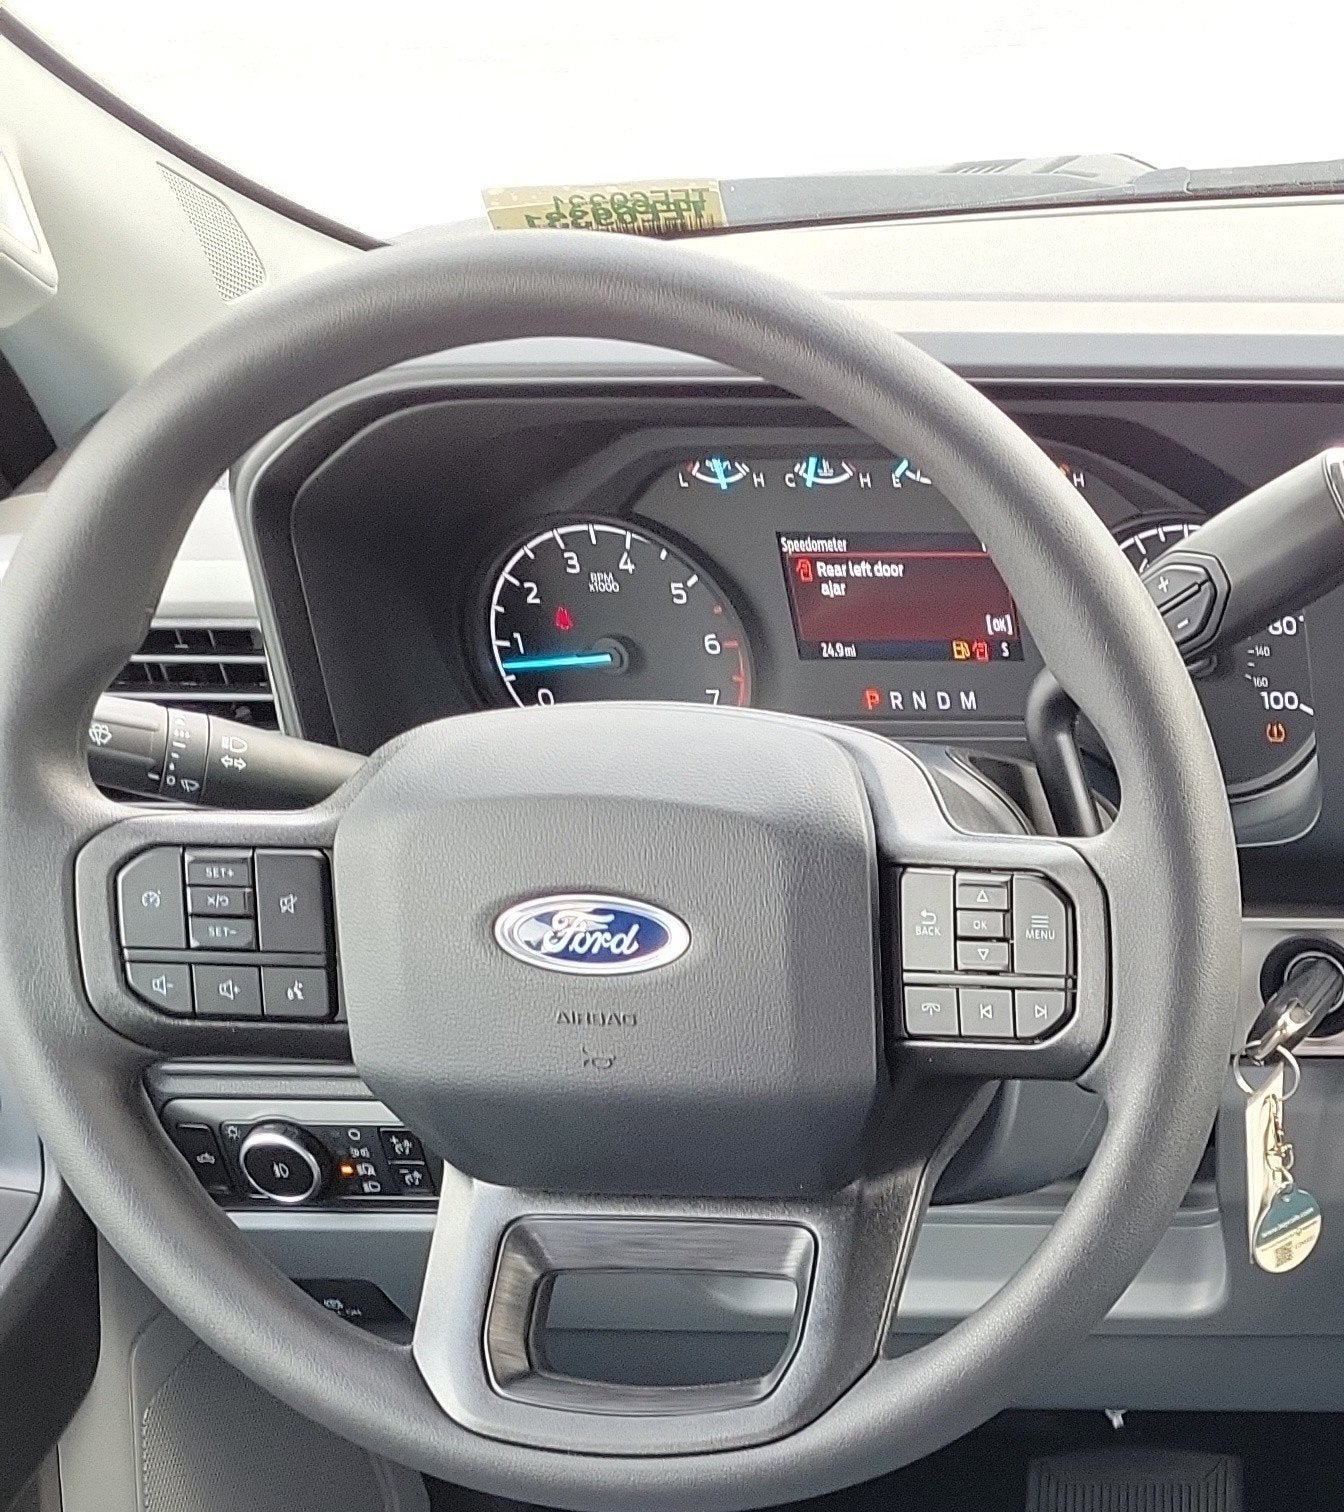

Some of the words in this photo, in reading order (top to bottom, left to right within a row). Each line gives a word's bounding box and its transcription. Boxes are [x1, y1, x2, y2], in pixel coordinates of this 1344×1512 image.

[678, 473, 689, 488] L
[753, 472, 765, 488] H
[785, 473, 796, 488] C
[859, 472, 872, 488] H
[1073, 473, 1085, 488] H
[780, 536, 847, 554] Speedometer
[564, 552, 581, 574] 3
[618, 552, 635, 574] 4
[816, 561, 847, 577] Rear
[849, 560, 873, 578] left
[874, 560, 904, 577] door
[590, 571, 615, 583] RPM
[524, 582, 541, 604] 2
[671, 582, 688, 605] 5
[821, 581, 846, 598] ajar
[512, 633, 525, 655] 1
[704, 633, 721, 655] 6
[1001, 641, 1010, 657] S
[1255, 645, 1270, 656] 140
[866, 689, 880, 709] P
[890, 690, 904, 710] R
[912, 690, 927, 710] N
[937, 691, 951, 710] D
[959, 691, 977, 710] M
[1260, 691, 1299, 710] 100
[206, 867, 234, 878] SET+
[541, 910, 640, 955] Ford
[915, 926, 941, 936] BACK
[973, 921, 987, 930] OK
[1025, 929, 1055, 940] MENU
